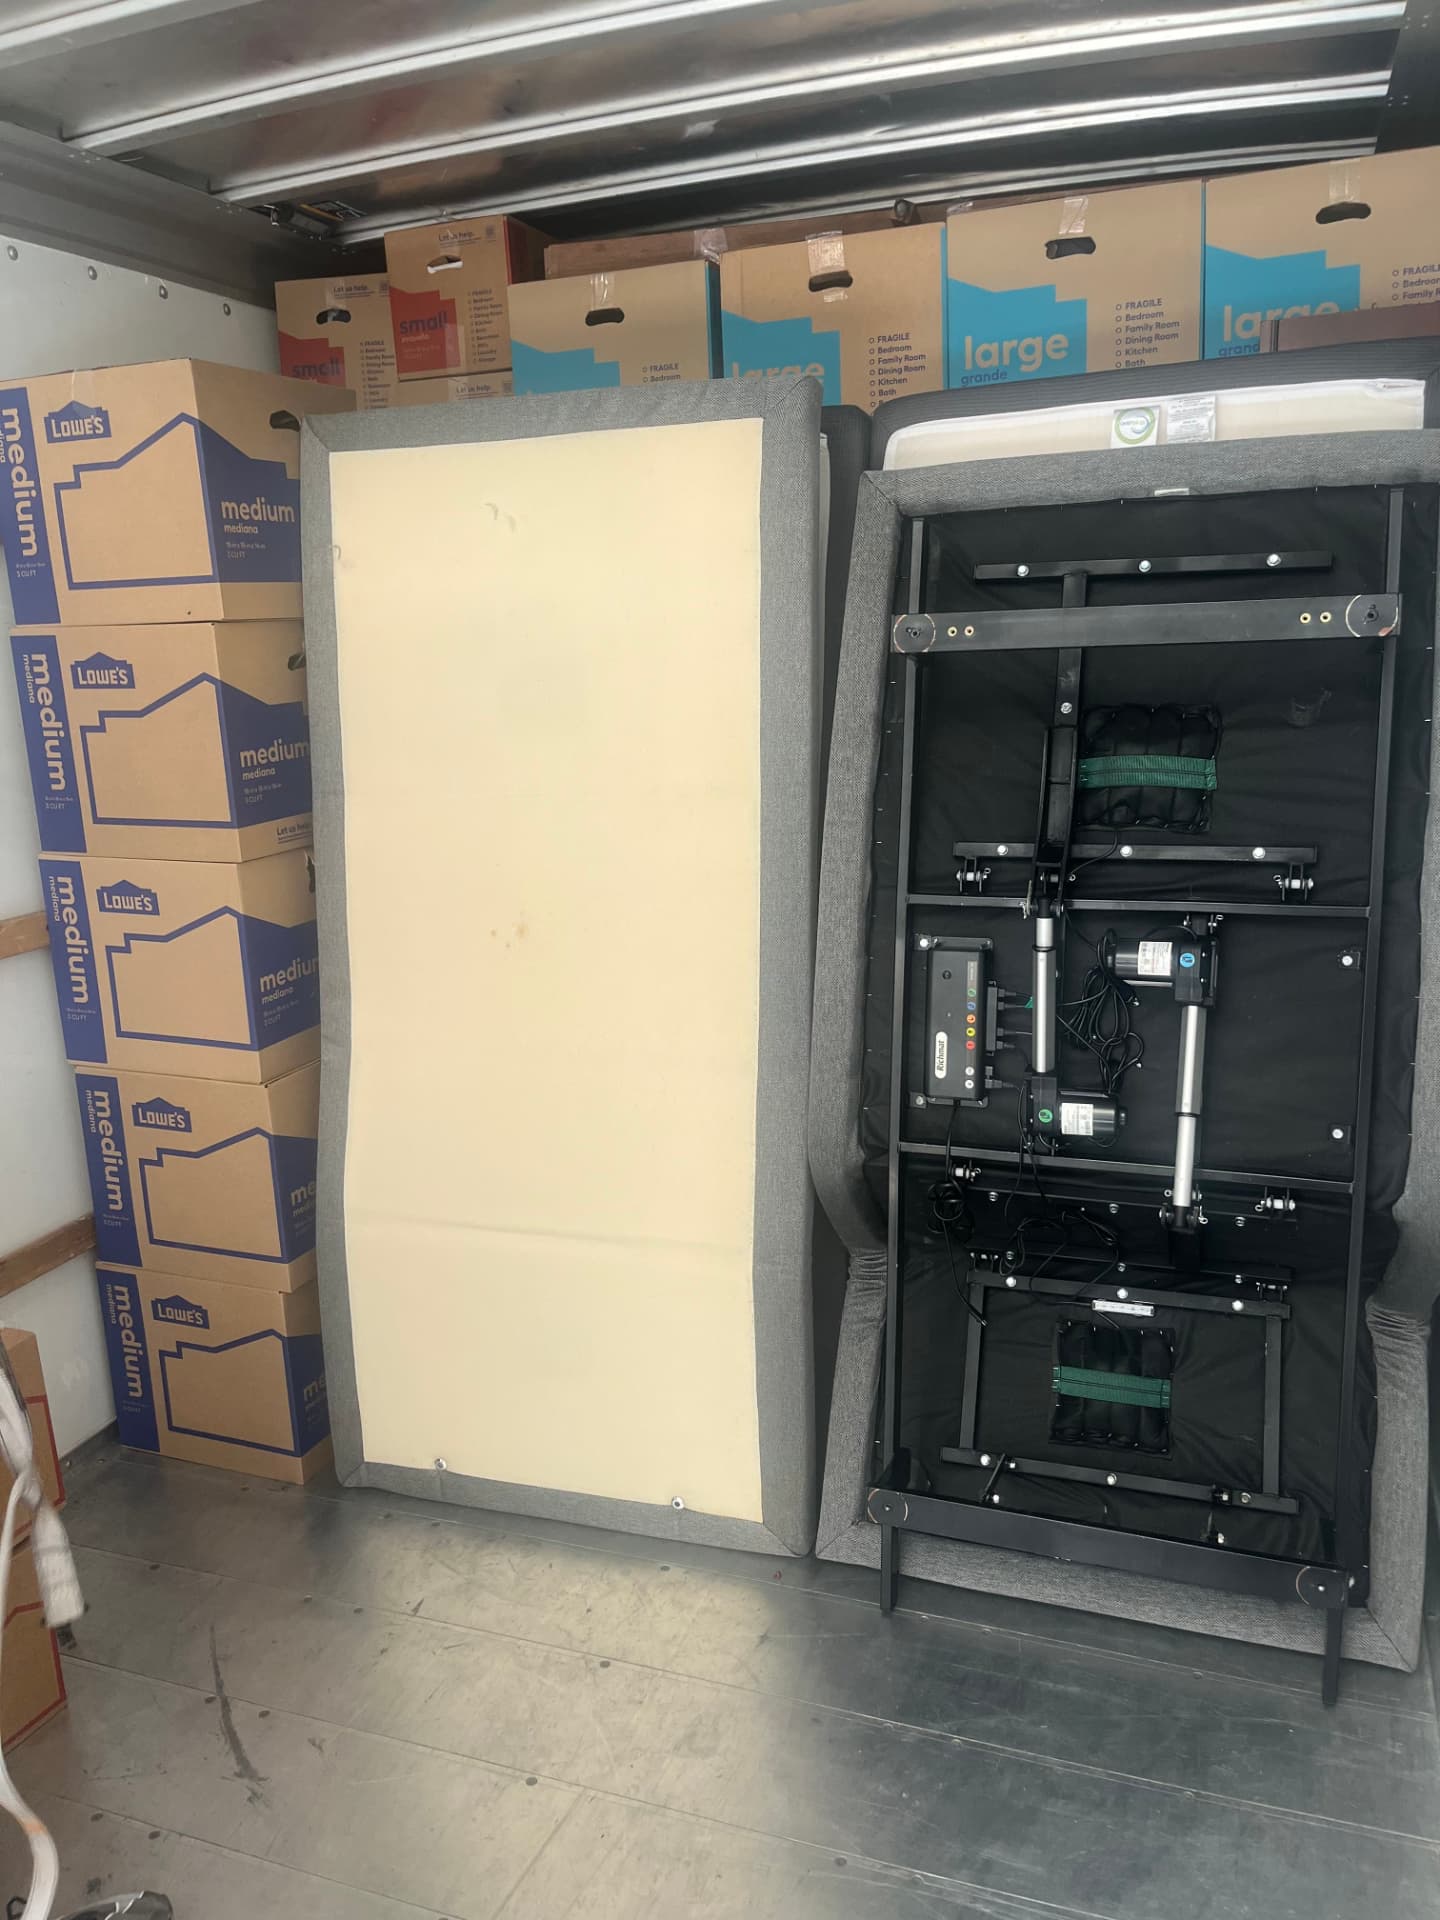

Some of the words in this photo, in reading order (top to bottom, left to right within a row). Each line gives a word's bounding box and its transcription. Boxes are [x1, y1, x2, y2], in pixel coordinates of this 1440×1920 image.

[1125, 297, 1163, 310] FRAGILE
[400, 310, 447, 336] small
[1125, 311, 1164, 322] Bedroom
[1125, 323, 1153, 333] Family
[1154, 320, 1180, 329] Room
[877, 332, 911, 344] FRAGILE
[1125, 335, 1153, 345] Dining
[1154, 332, 1179, 341] Room
[877, 344, 913, 354] Bedroom
[878, 354, 904, 365] Family
[904, 353, 927, 362] Room
[965, 333, 1069, 372] large
[1125, 346, 1159, 356] Kitchen
[291, 356, 340, 378] small
[878, 366, 904, 376] Dining
[903, 365, 927, 373] Room
[1125, 359, 1146, 368] Bath
[878, 377, 908, 386] Kitchen
[960, 368, 1008, 387] grande
[878, 388, 897, 397] Bath
[51, 415, 104, 438] LOWE'S
[2, 408, 37, 557] medium
[221, 496, 296, 522] medium
[223, 522, 259, 534] mediana
[23, 654, 35, 704] mediana
[77, 666, 129, 685] LOWE'S
[31, 653, 66, 791] medium
[240, 738, 308, 767] medium
[242, 767, 276, 781] mediana
[48, 876, 60, 922] mediana
[103, 892, 153, 911] LOWE'S
[57, 876, 89, 1004] medium
[936, 1039, 945, 1072] Richmat
[85, 1090, 97, 1133] mediana
[138, 1106, 186, 1128] LOWE'S
[94, 1090, 123, 1211] medium
[157, 1303, 204, 1325] LOWE'S
[113, 1285, 144, 1398] medium
